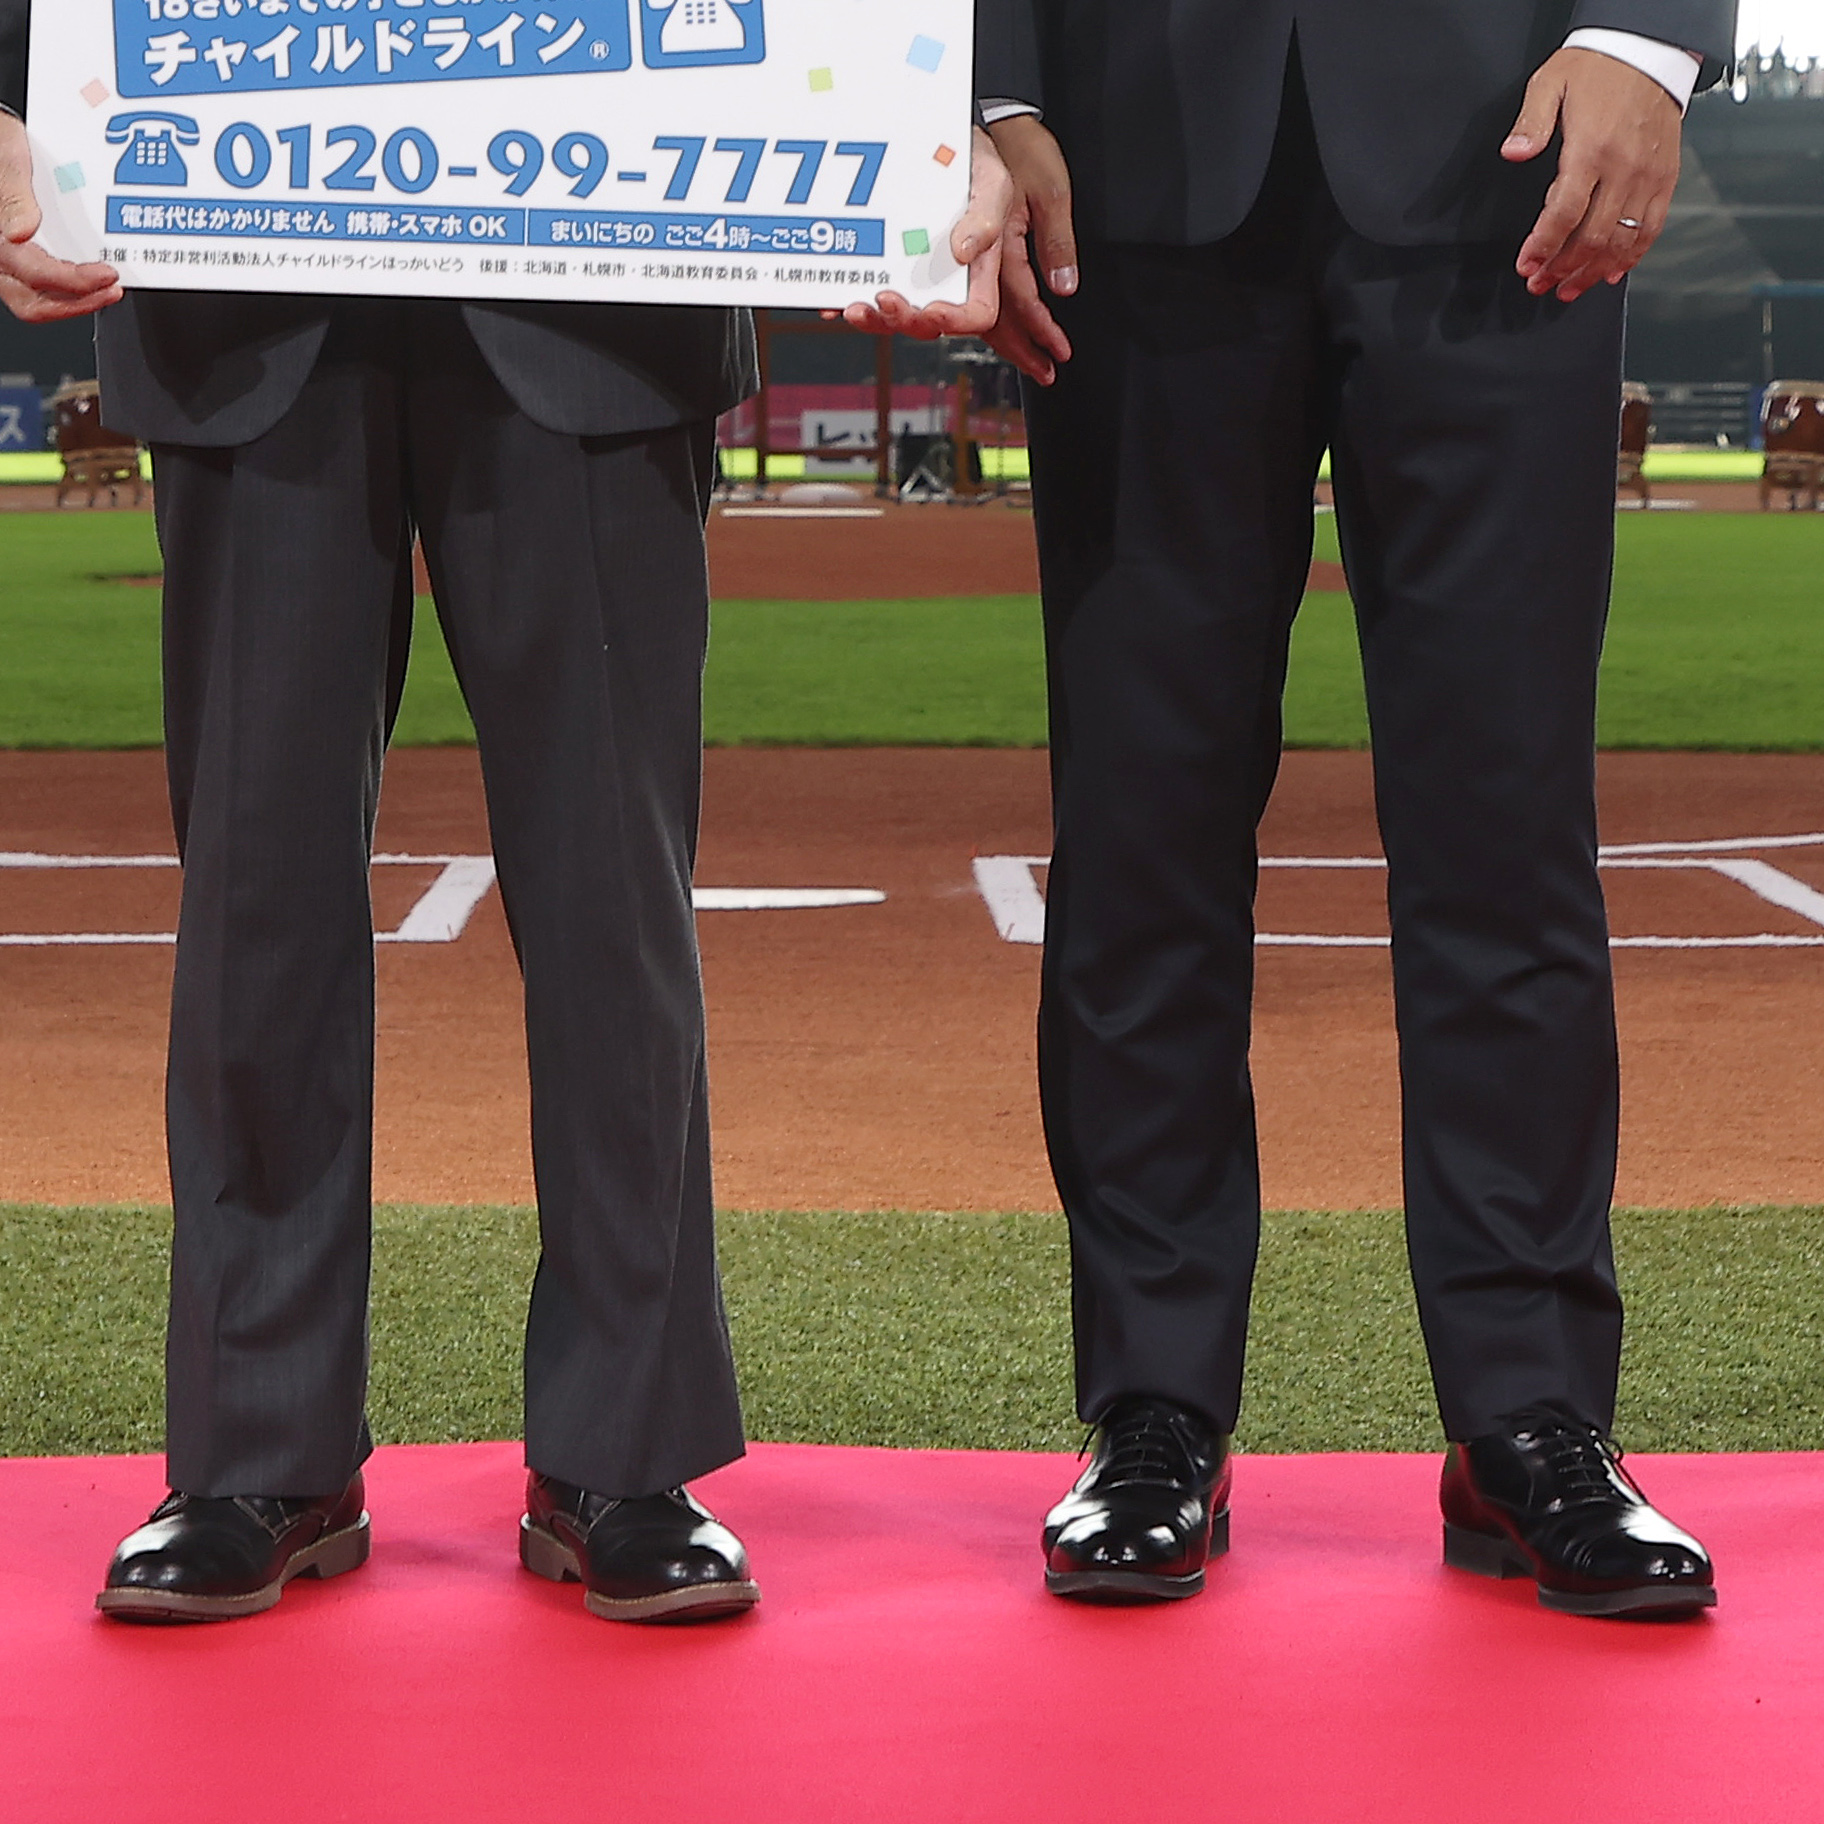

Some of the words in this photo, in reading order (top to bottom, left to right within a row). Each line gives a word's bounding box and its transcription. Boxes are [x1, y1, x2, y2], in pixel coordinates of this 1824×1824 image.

[214, 121, 889, 206] 0120-99-7777
[120, 204, 336, 234] 電話代はかかりません
[346, 210, 463, 237] 携帯・スマホ
[468, 215, 507, 238] OK
[551, 218, 655, 245] まいにちの
